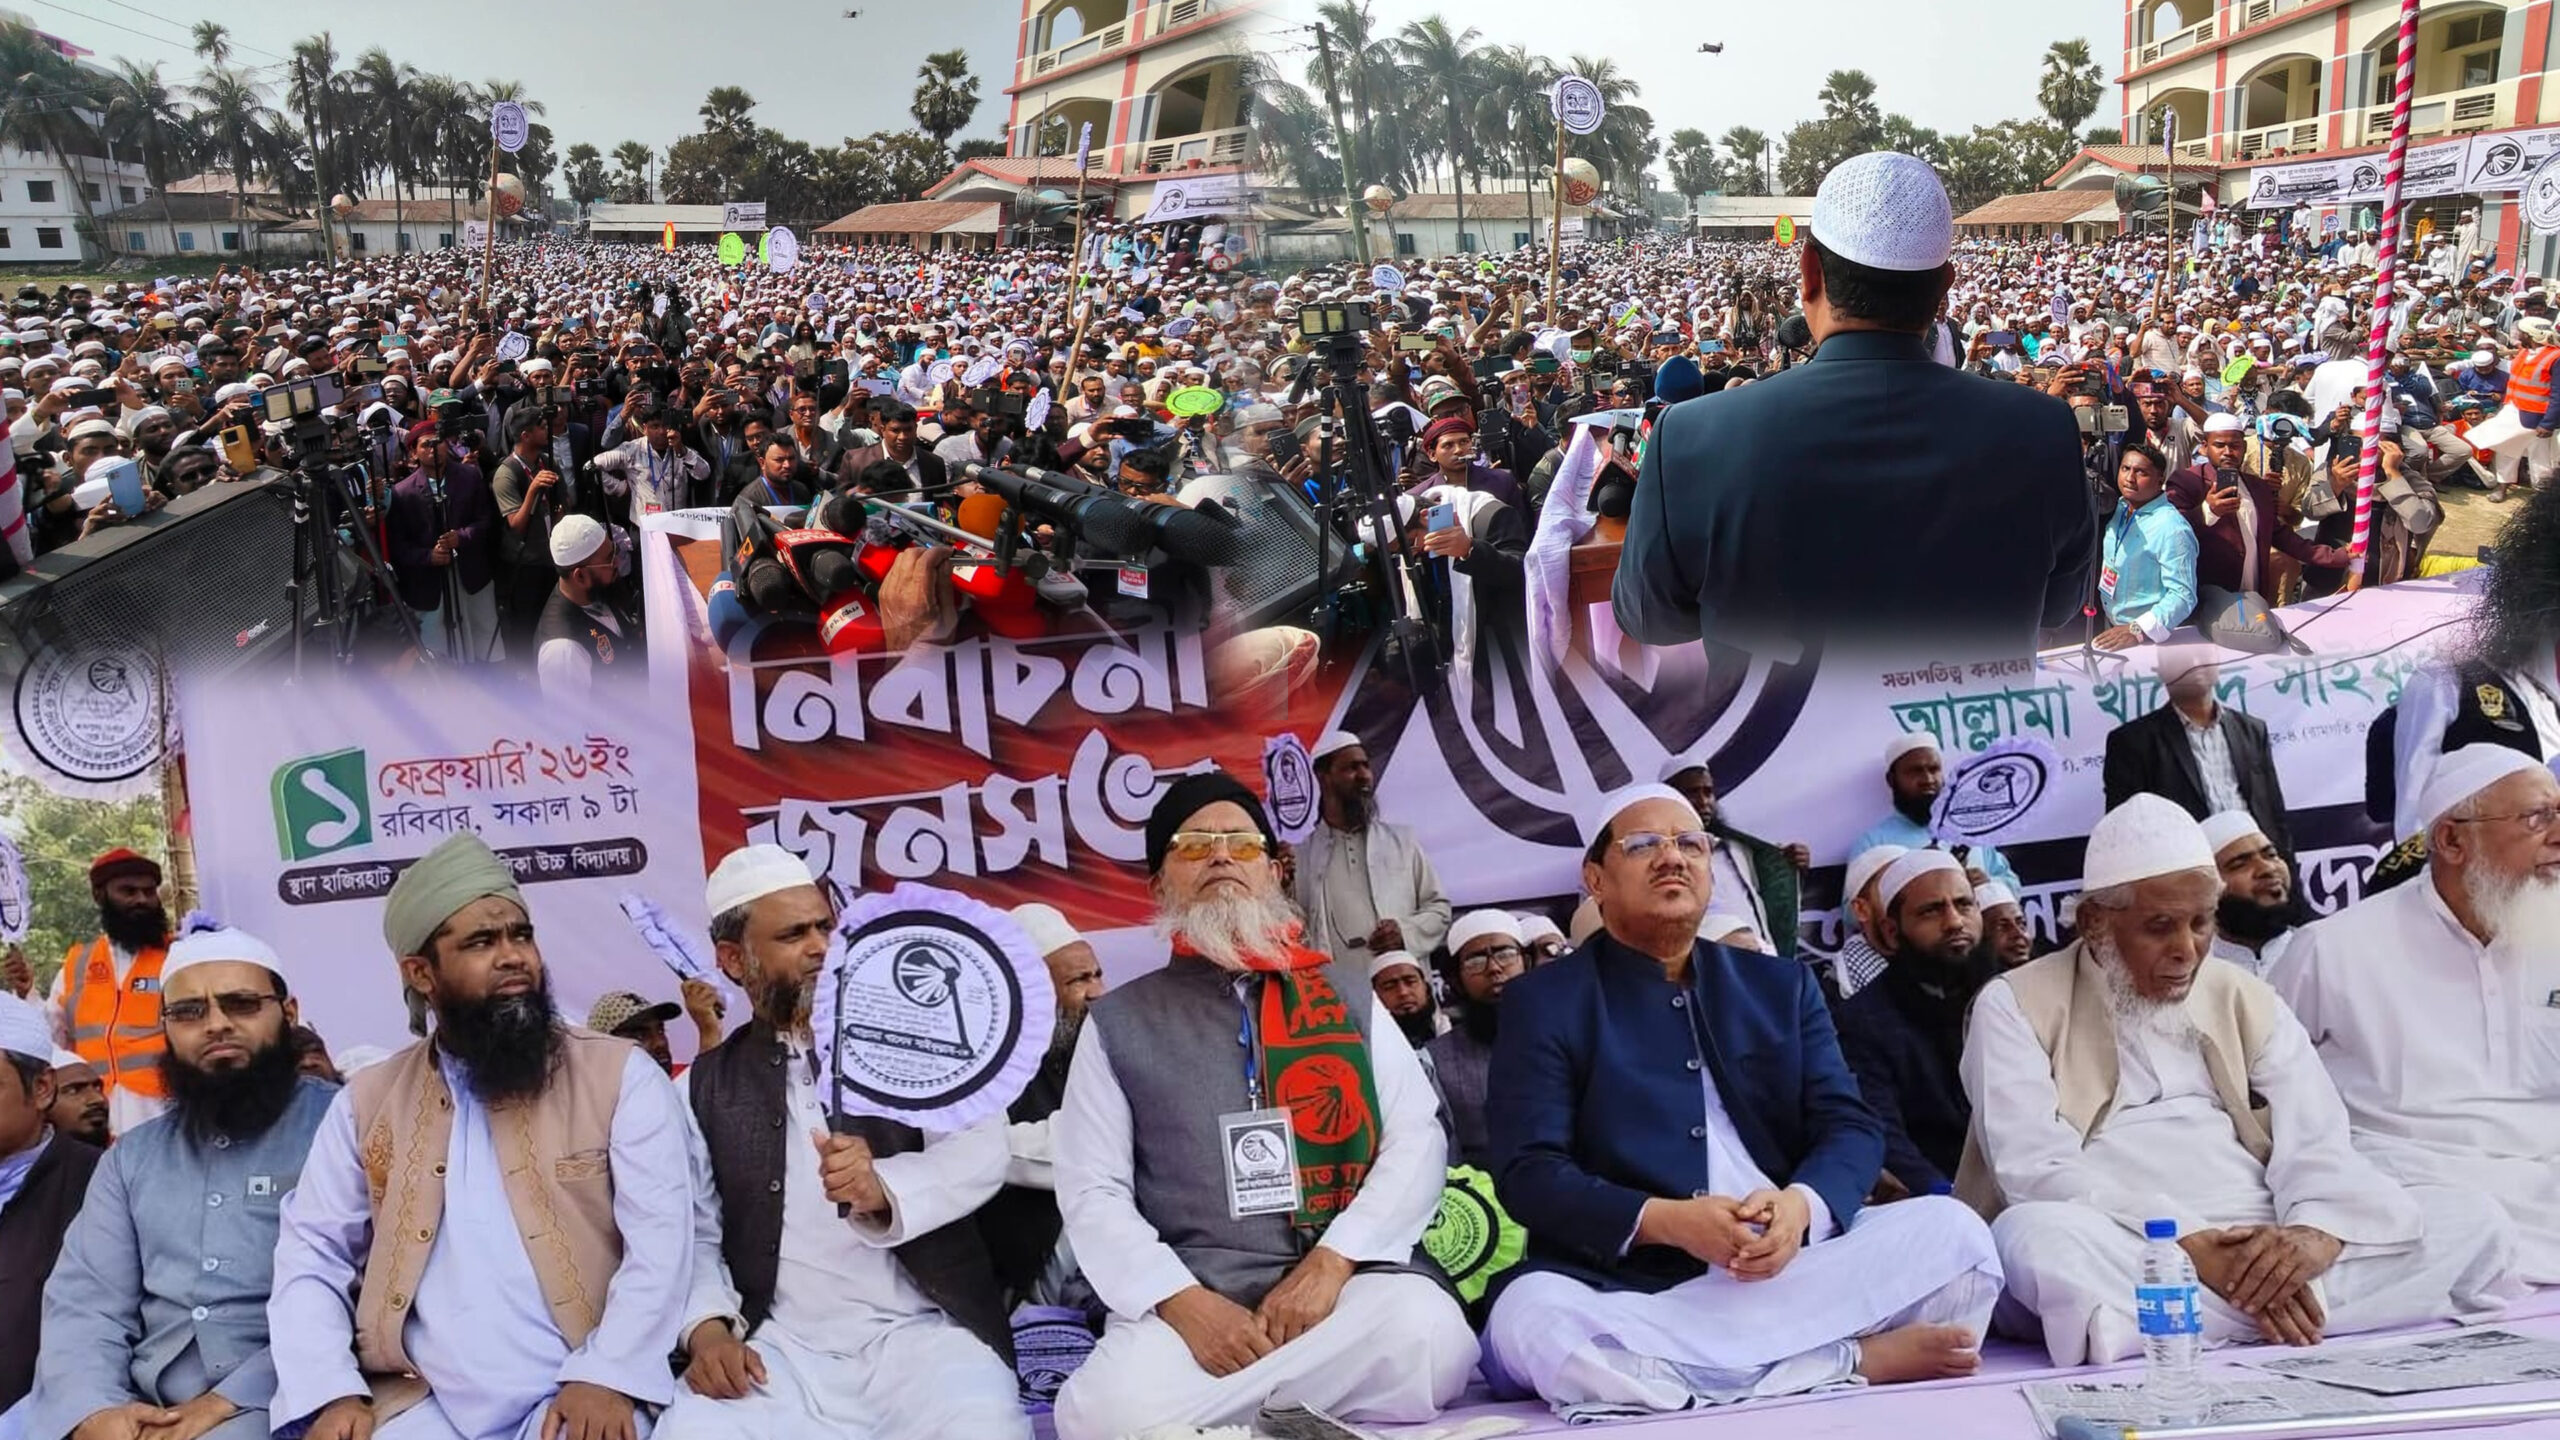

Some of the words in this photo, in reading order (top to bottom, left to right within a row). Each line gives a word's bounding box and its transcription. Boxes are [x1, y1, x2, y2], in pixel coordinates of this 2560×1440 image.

[1889, 680, 2075, 753] আল্লামা
[301, 768, 361, 849] ১
[379, 801, 482, 838] রবিবার,
[492, 797, 571, 827] সকাল
[582, 795, 601, 819] ৯
[607, 782, 638, 814] টা
[534, 849, 569, 872] উচ্চ
